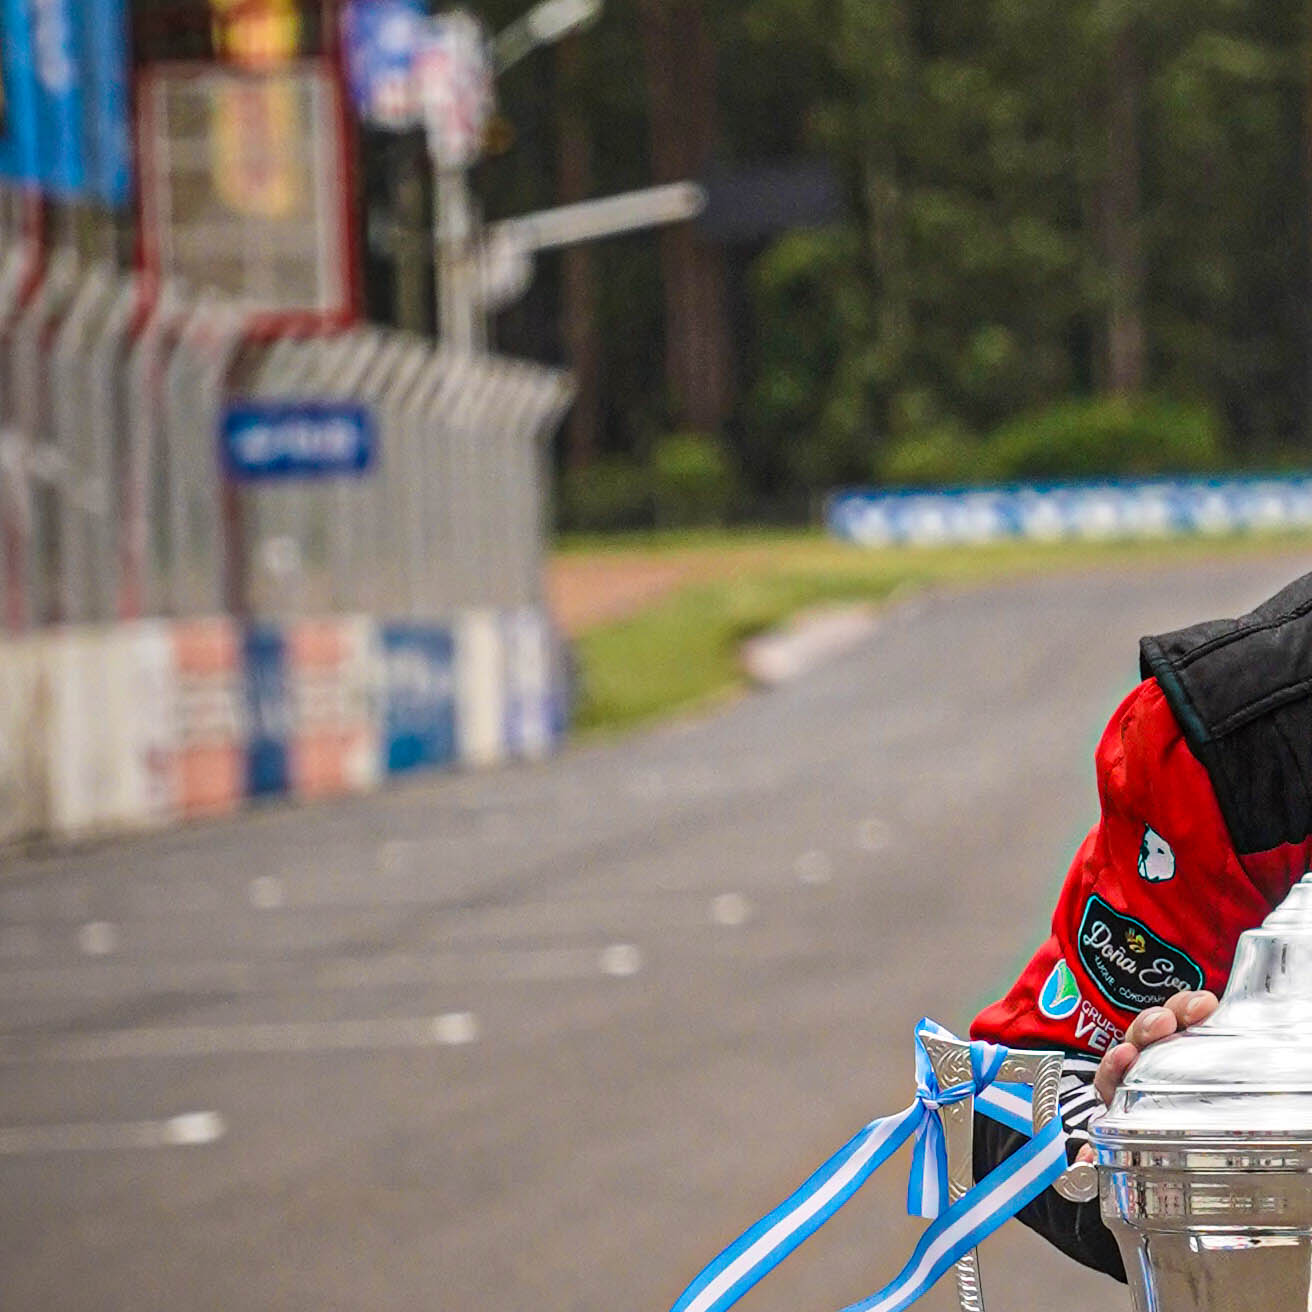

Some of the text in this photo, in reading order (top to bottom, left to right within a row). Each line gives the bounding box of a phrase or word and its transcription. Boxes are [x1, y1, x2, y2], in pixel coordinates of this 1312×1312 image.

[1082, 920, 1192, 992] Doña Eva
[1081, 1000, 1125, 1041] GRUPO
